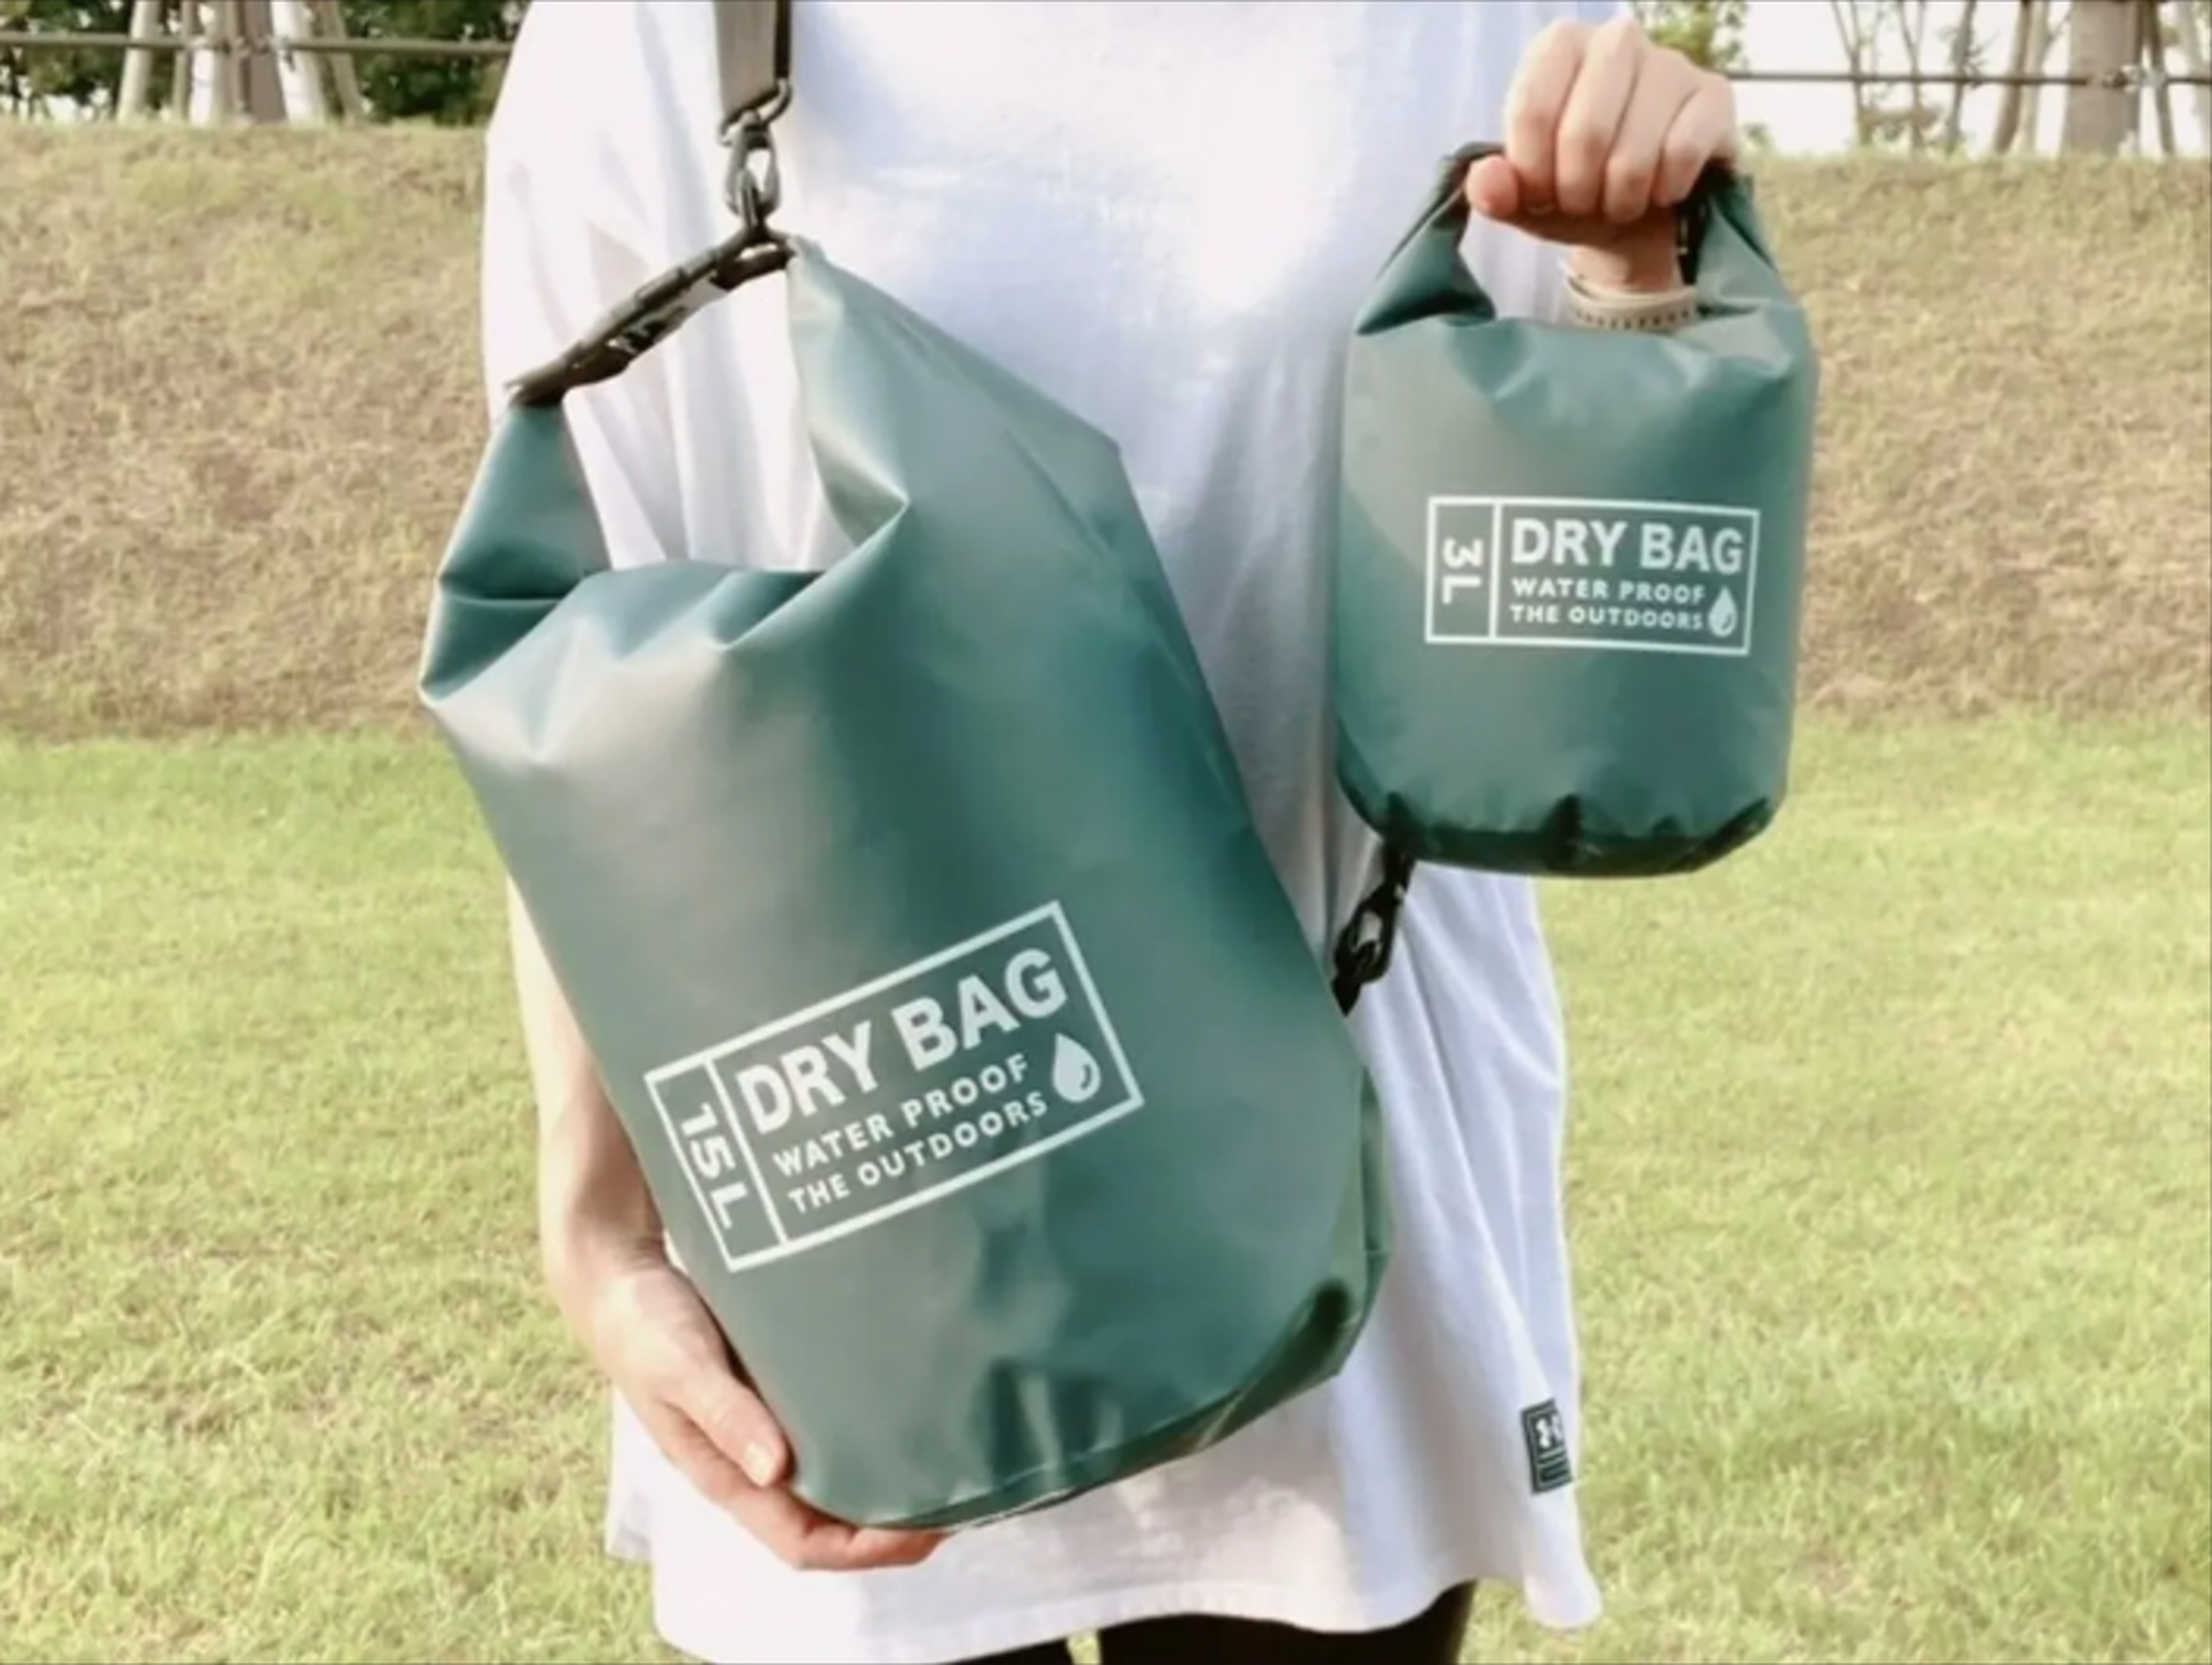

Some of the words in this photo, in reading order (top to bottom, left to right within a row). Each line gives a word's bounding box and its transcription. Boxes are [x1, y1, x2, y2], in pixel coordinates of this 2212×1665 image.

[1511, 518, 1628, 567] DRY
[1639, 523, 1744, 575] BAG
[1512, 577, 1609, 599] WATER
[1619, 580, 1705, 604] PROOF
[1509, 604, 1559, 624] THE
[1567, 605, 1703, 630] OUTDOORS
[736, 1020, 878, 1134] DRY
[891, 948, 1067, 1072] BAG
[772, 1112, 894, 1176] WATER
[900, 1053, 1029, 1128] PROOF
[787, 1173, 850, 1213] THE
[857, 1091, 1048, 1187] OUTDOORS
